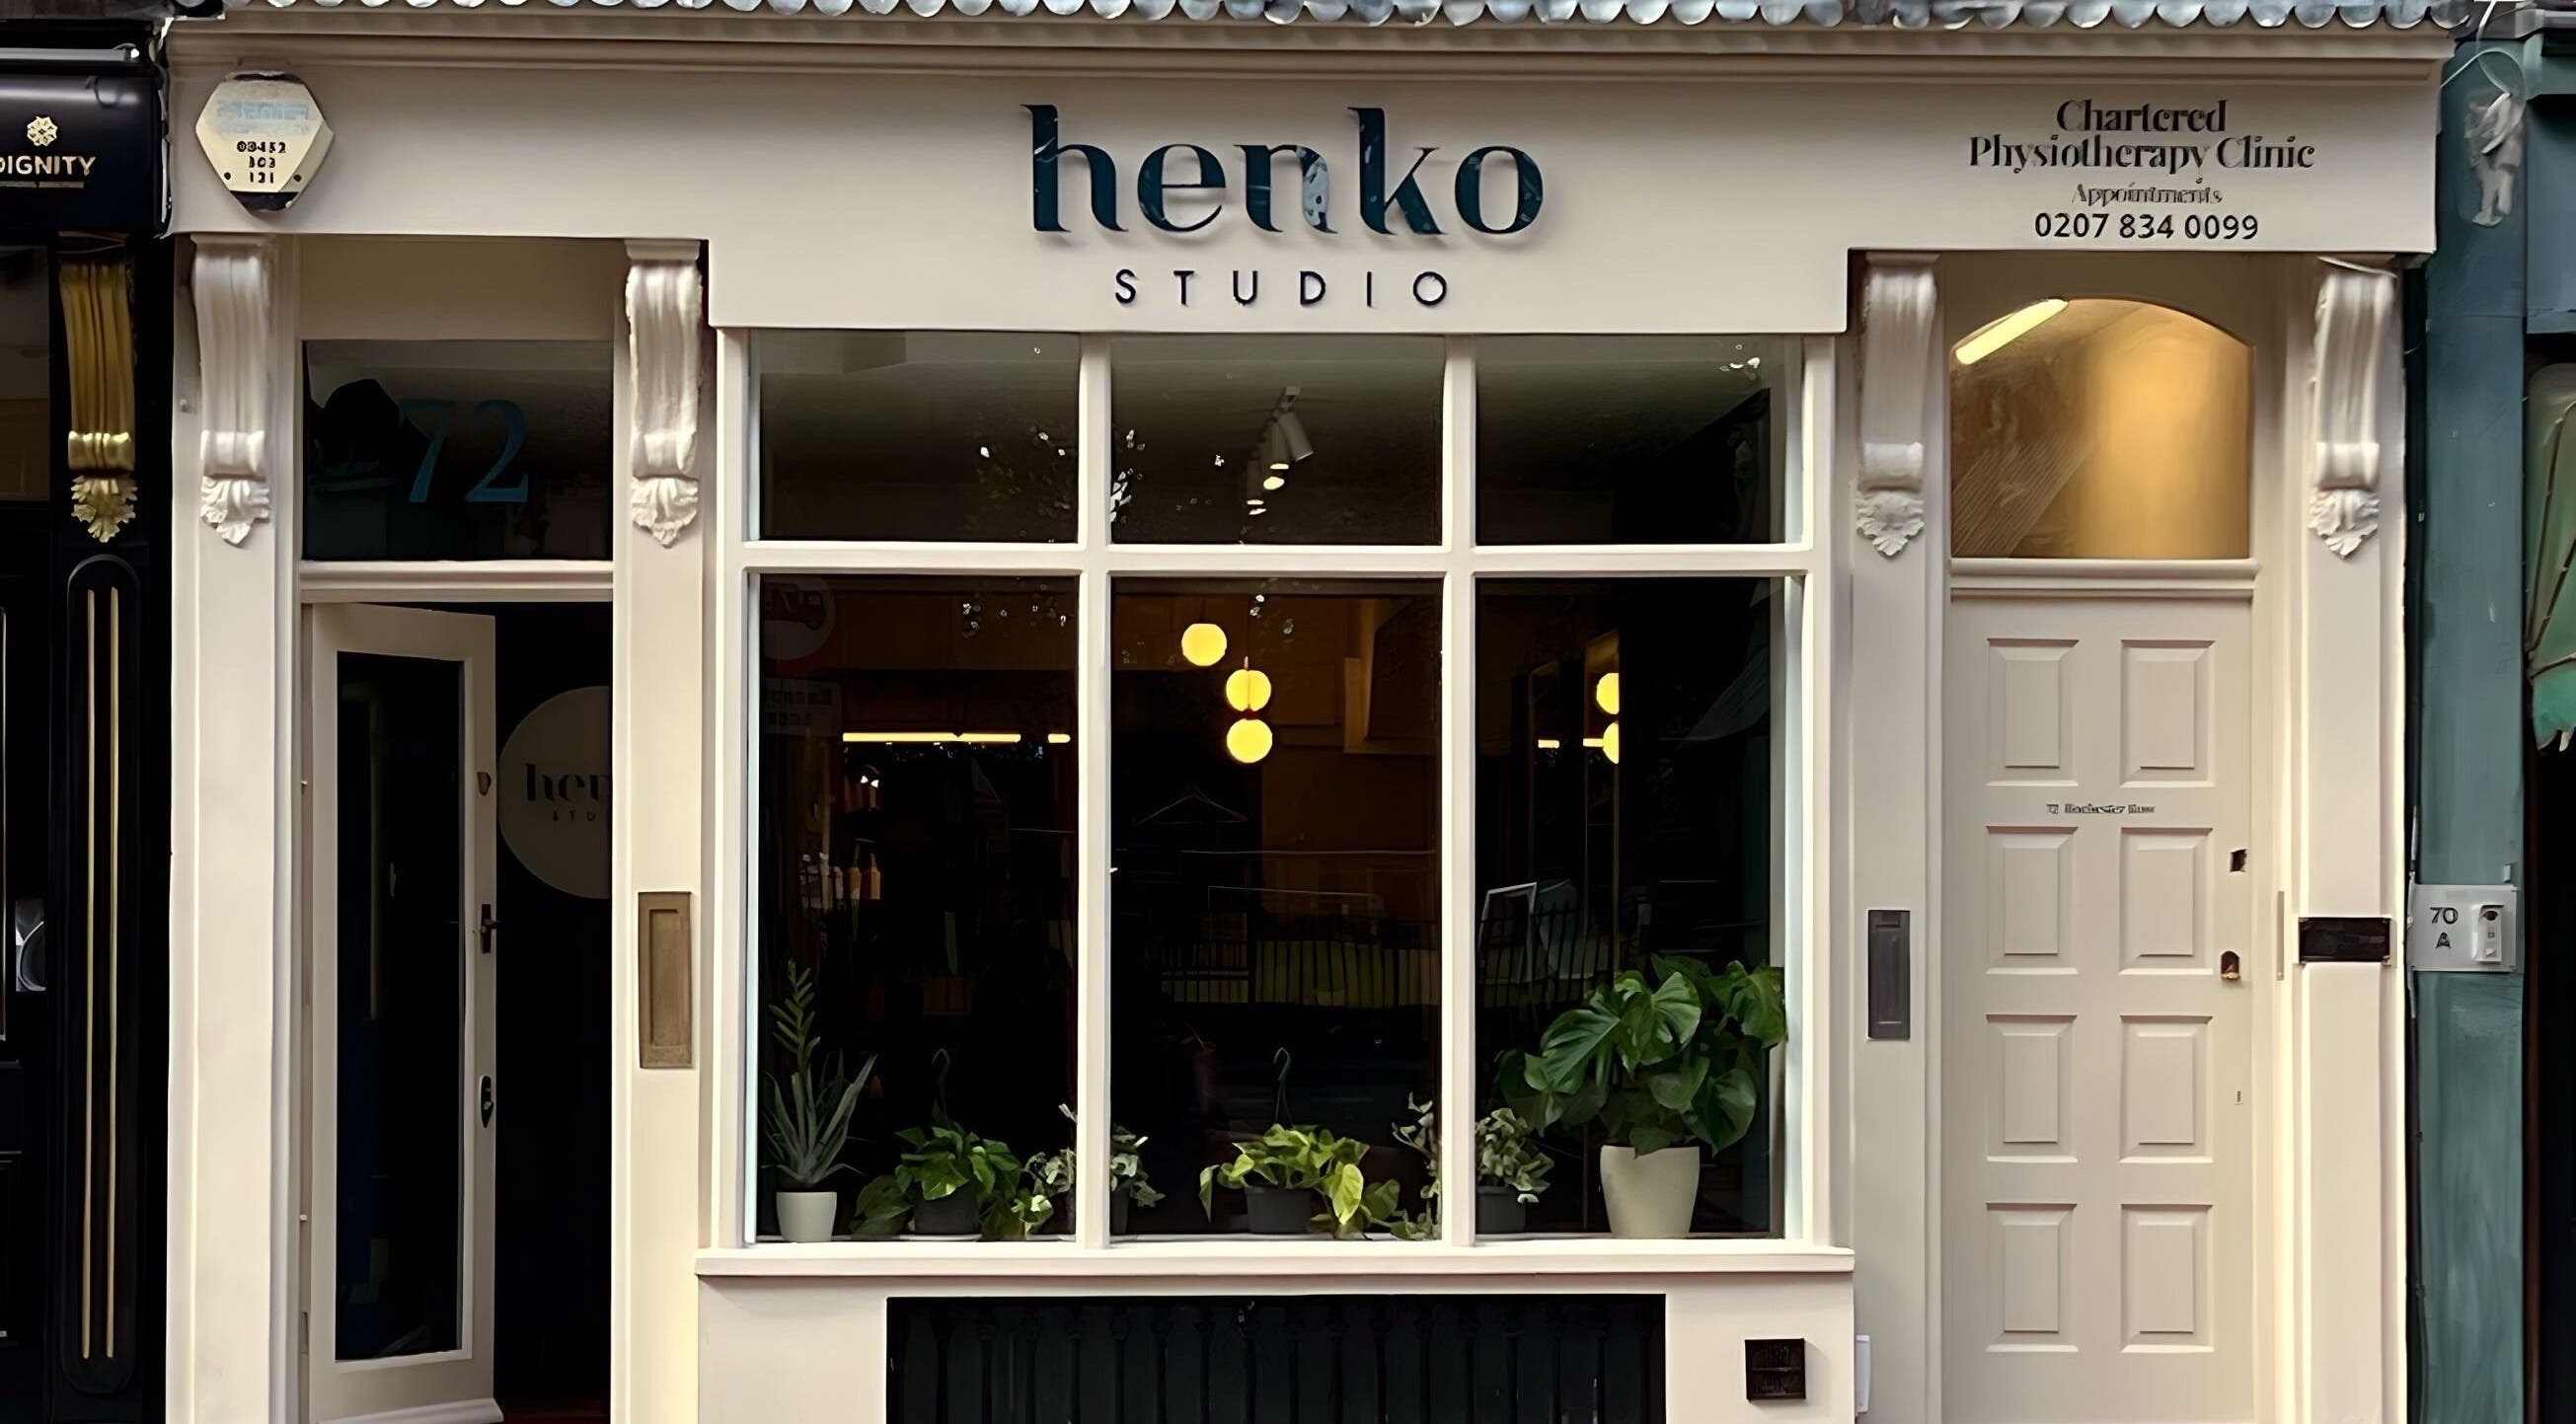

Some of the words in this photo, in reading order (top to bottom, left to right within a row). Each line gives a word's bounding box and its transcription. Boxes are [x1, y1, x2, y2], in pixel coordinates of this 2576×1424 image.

[2056, 100, 2227, 132] Chartered
[0, 155, 96, 176] DIGNITY
[1021, 104, 1544, 235] henko
[1969, 134, 2211, 174] Physiotherapy
[2217, 136, 2314, 168] Clinic
[2034, 212, 2109, 239] 0207
[2119, 213, 2174, 239] 834
[2184, 214, 2259, 240] 0099
[1114, 268, 1448, 308] STUDIO
[398, 398, 529, 504] 72
[2430, 907, 2459, 925] 70
